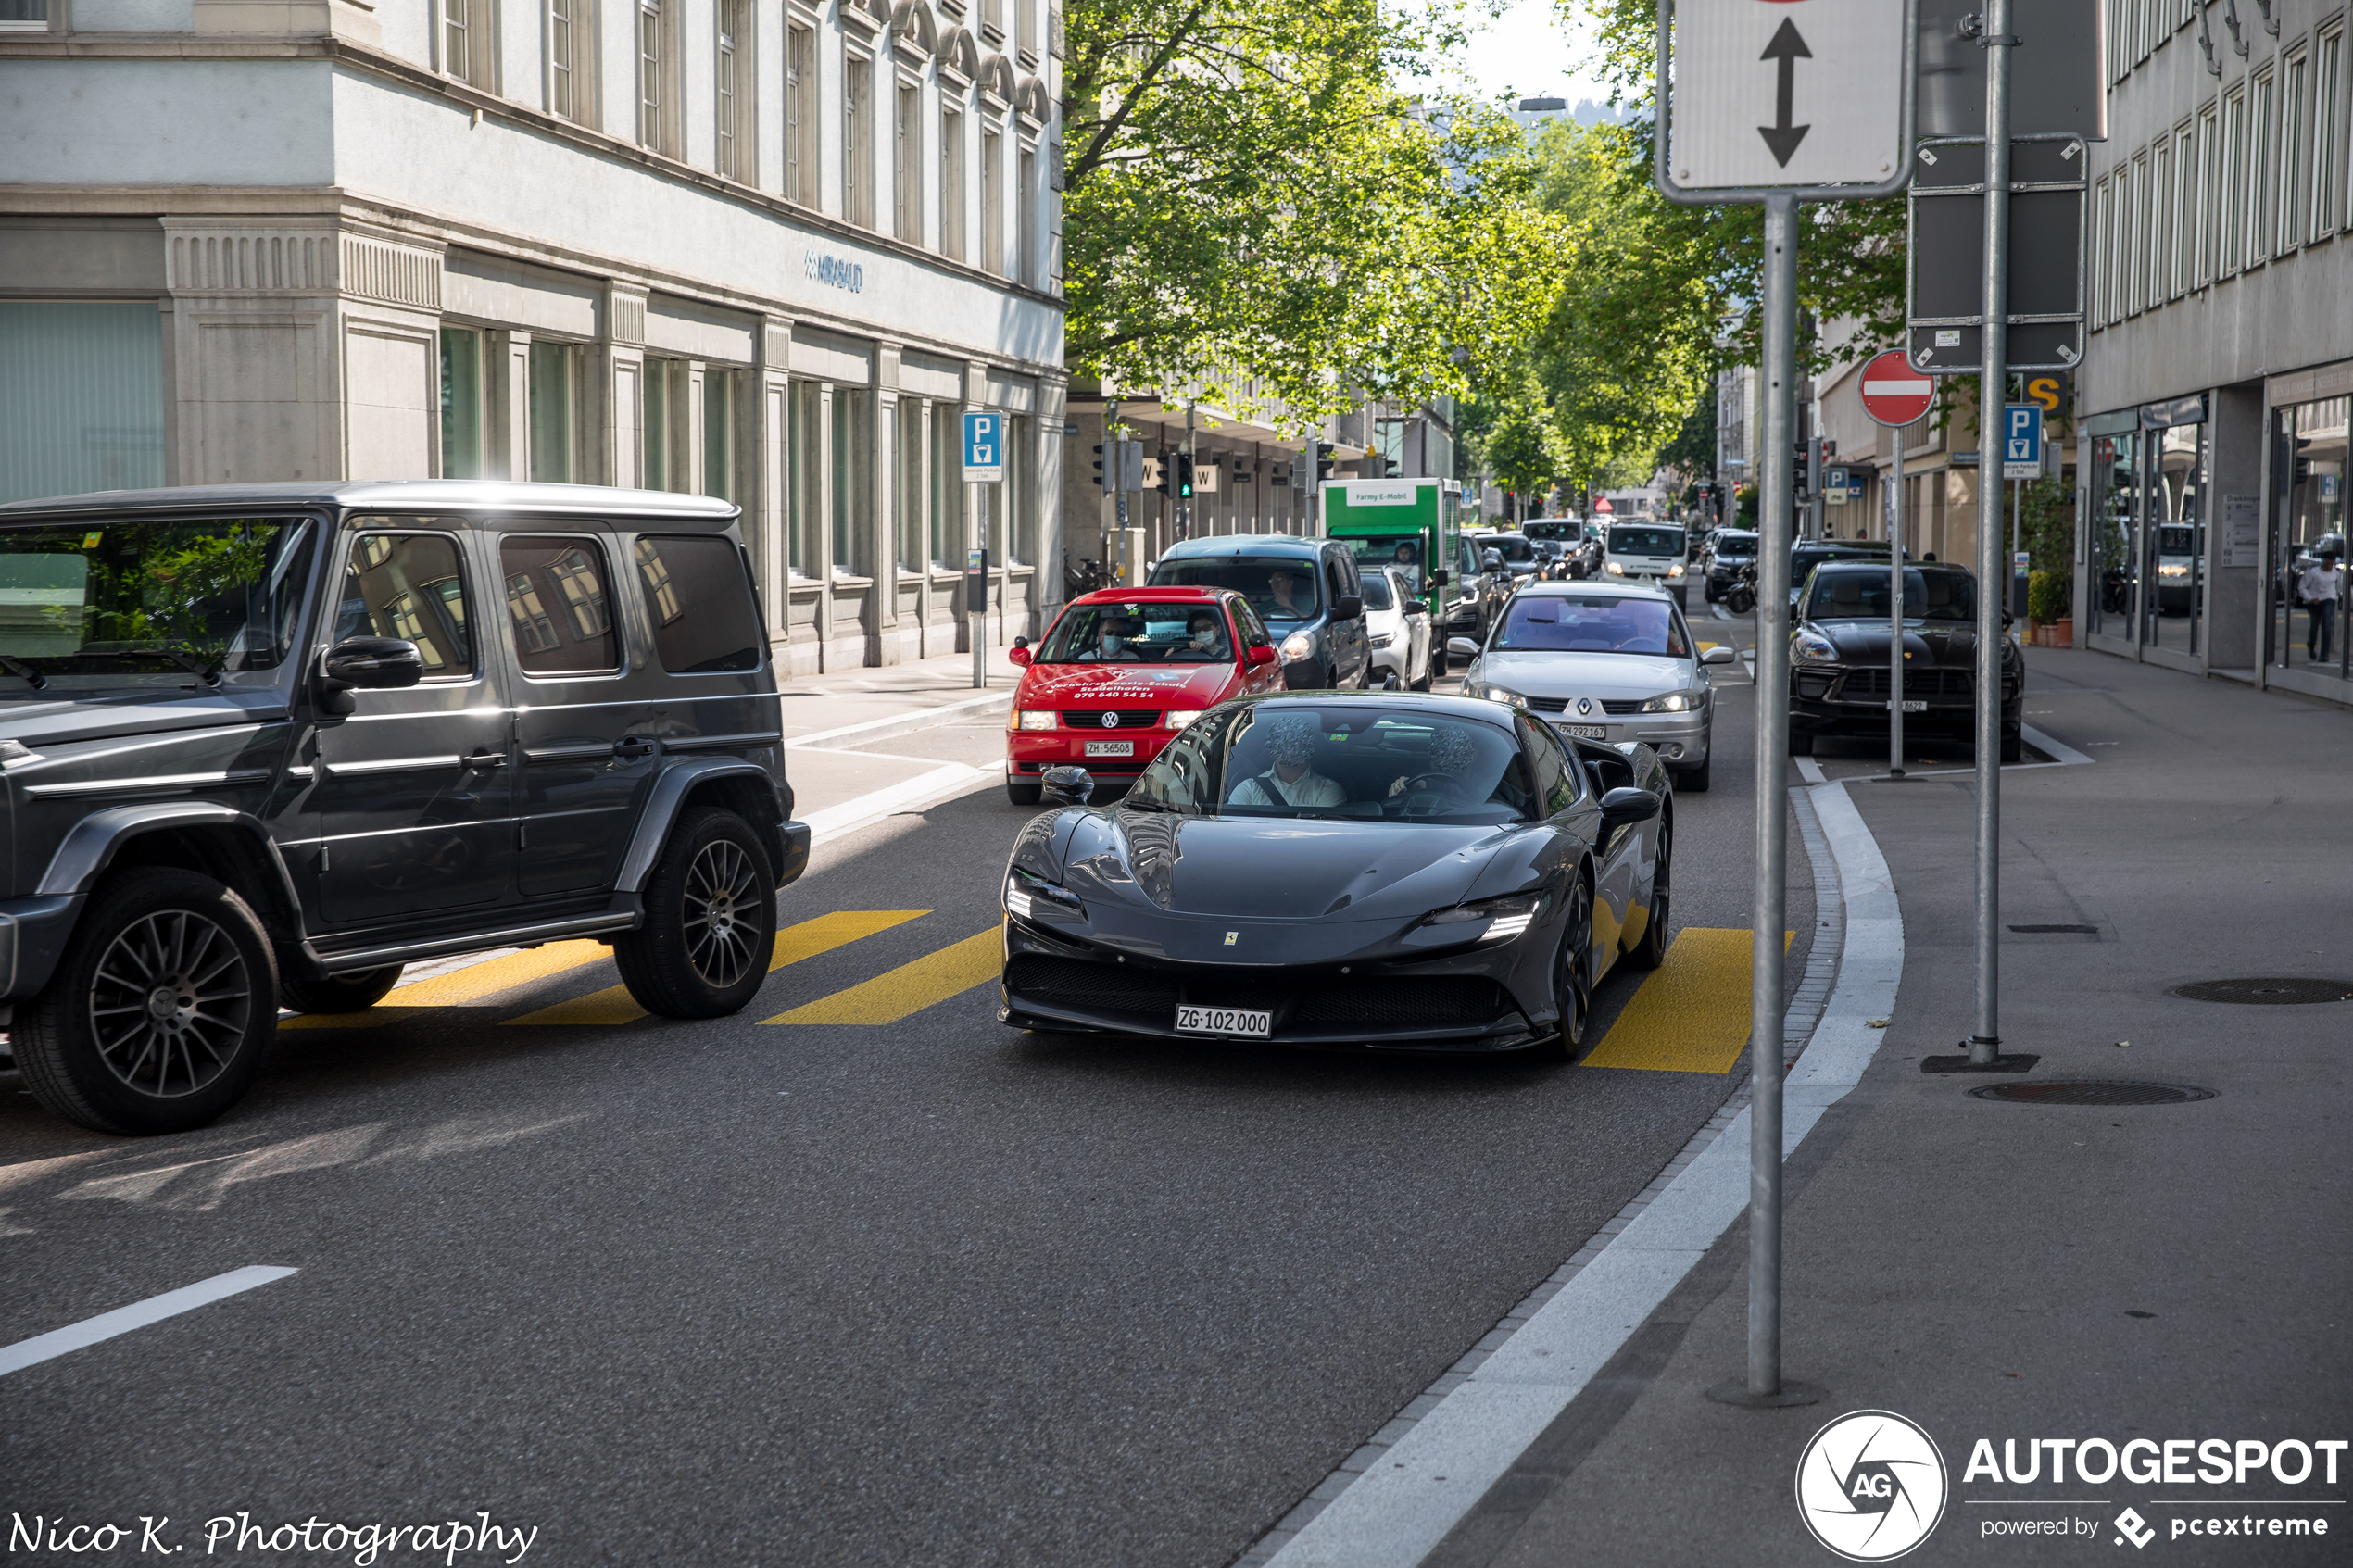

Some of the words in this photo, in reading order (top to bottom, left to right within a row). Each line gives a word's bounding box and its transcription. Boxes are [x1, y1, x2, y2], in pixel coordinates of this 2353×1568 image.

[817, 254, 863, 294] MIRABAUD
[2028, 378, 2060, 411] S
[975, 417, 991, 443] P
[2011, 410, 2030, 437] P
[1198, 471, 1209, 485] W
[1831, 471, 1843, 486] P
